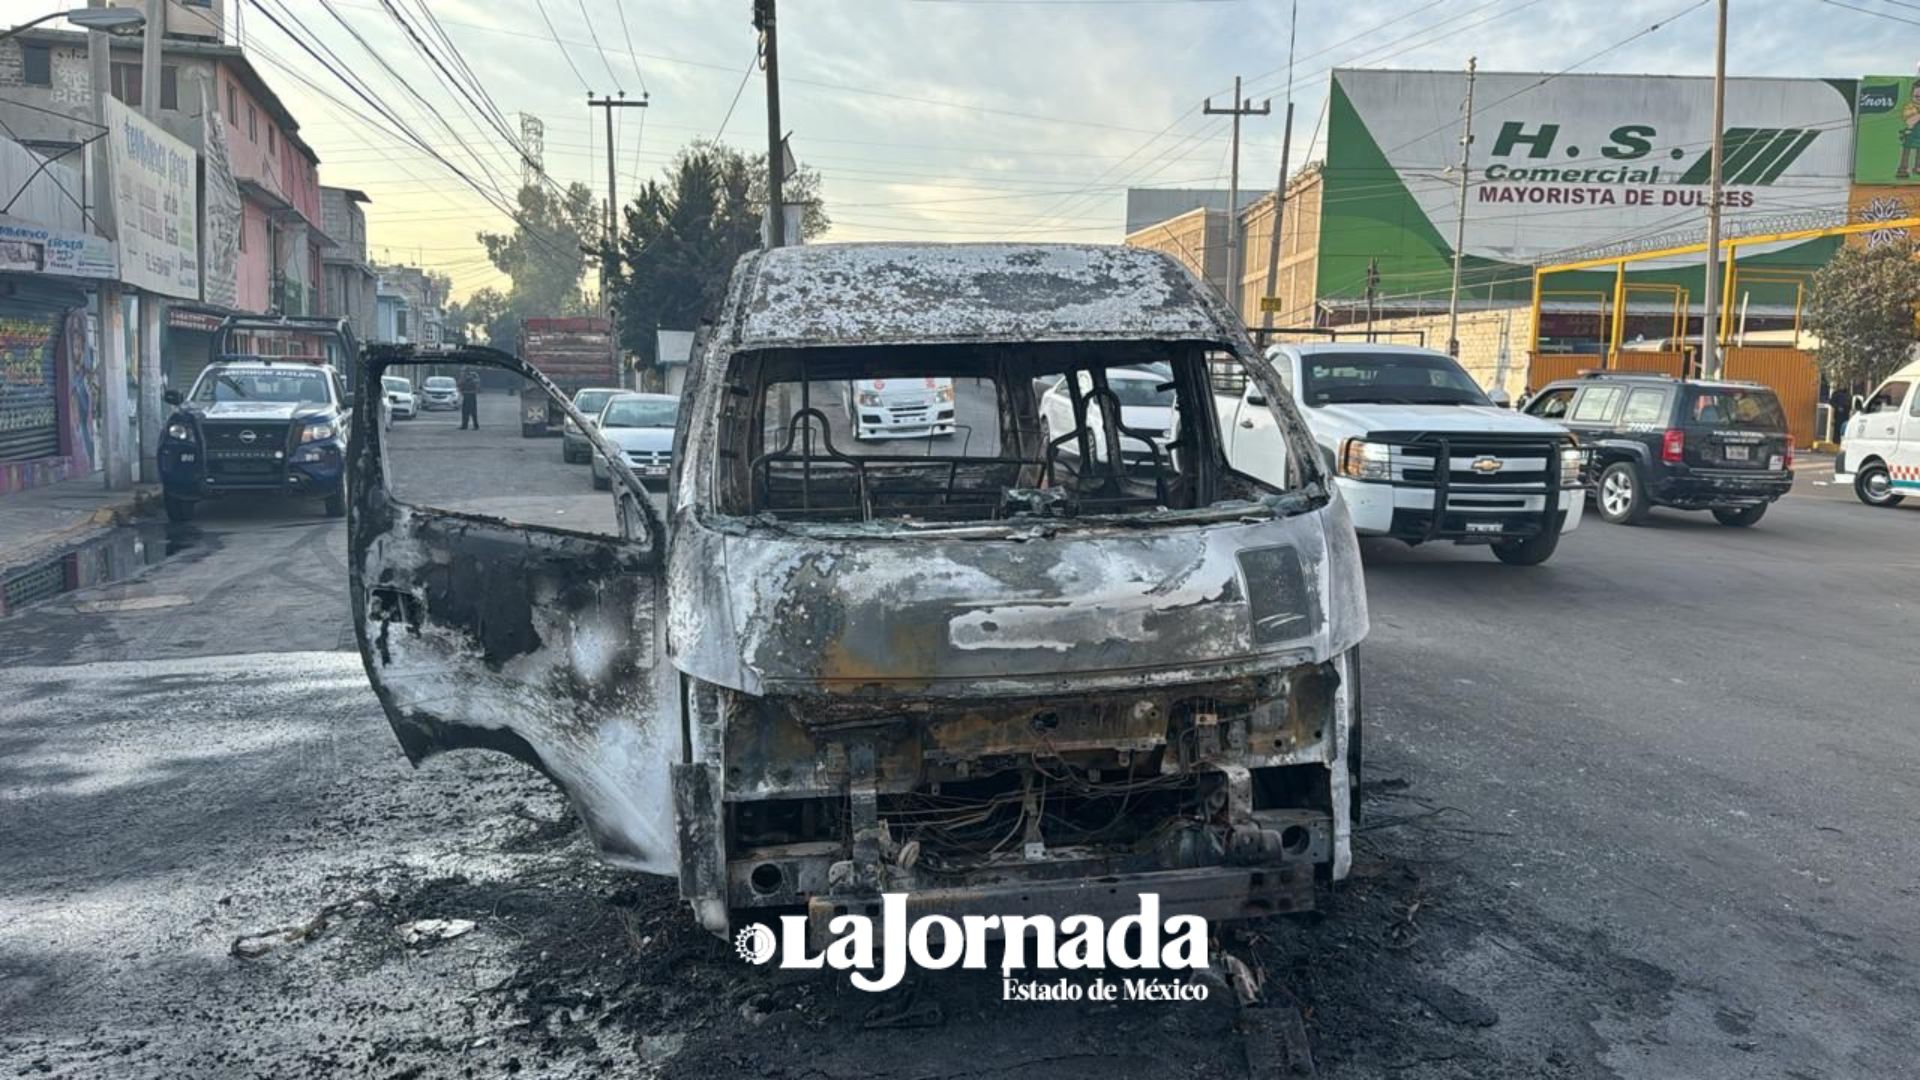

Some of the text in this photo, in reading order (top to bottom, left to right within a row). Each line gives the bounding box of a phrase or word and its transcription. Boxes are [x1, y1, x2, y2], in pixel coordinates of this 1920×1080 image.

[1484, 164, 1660, 184] Comercial
[1479, 186, 1616, 205] MAYORISTA
[1625, 189, 1655, 206] DE
